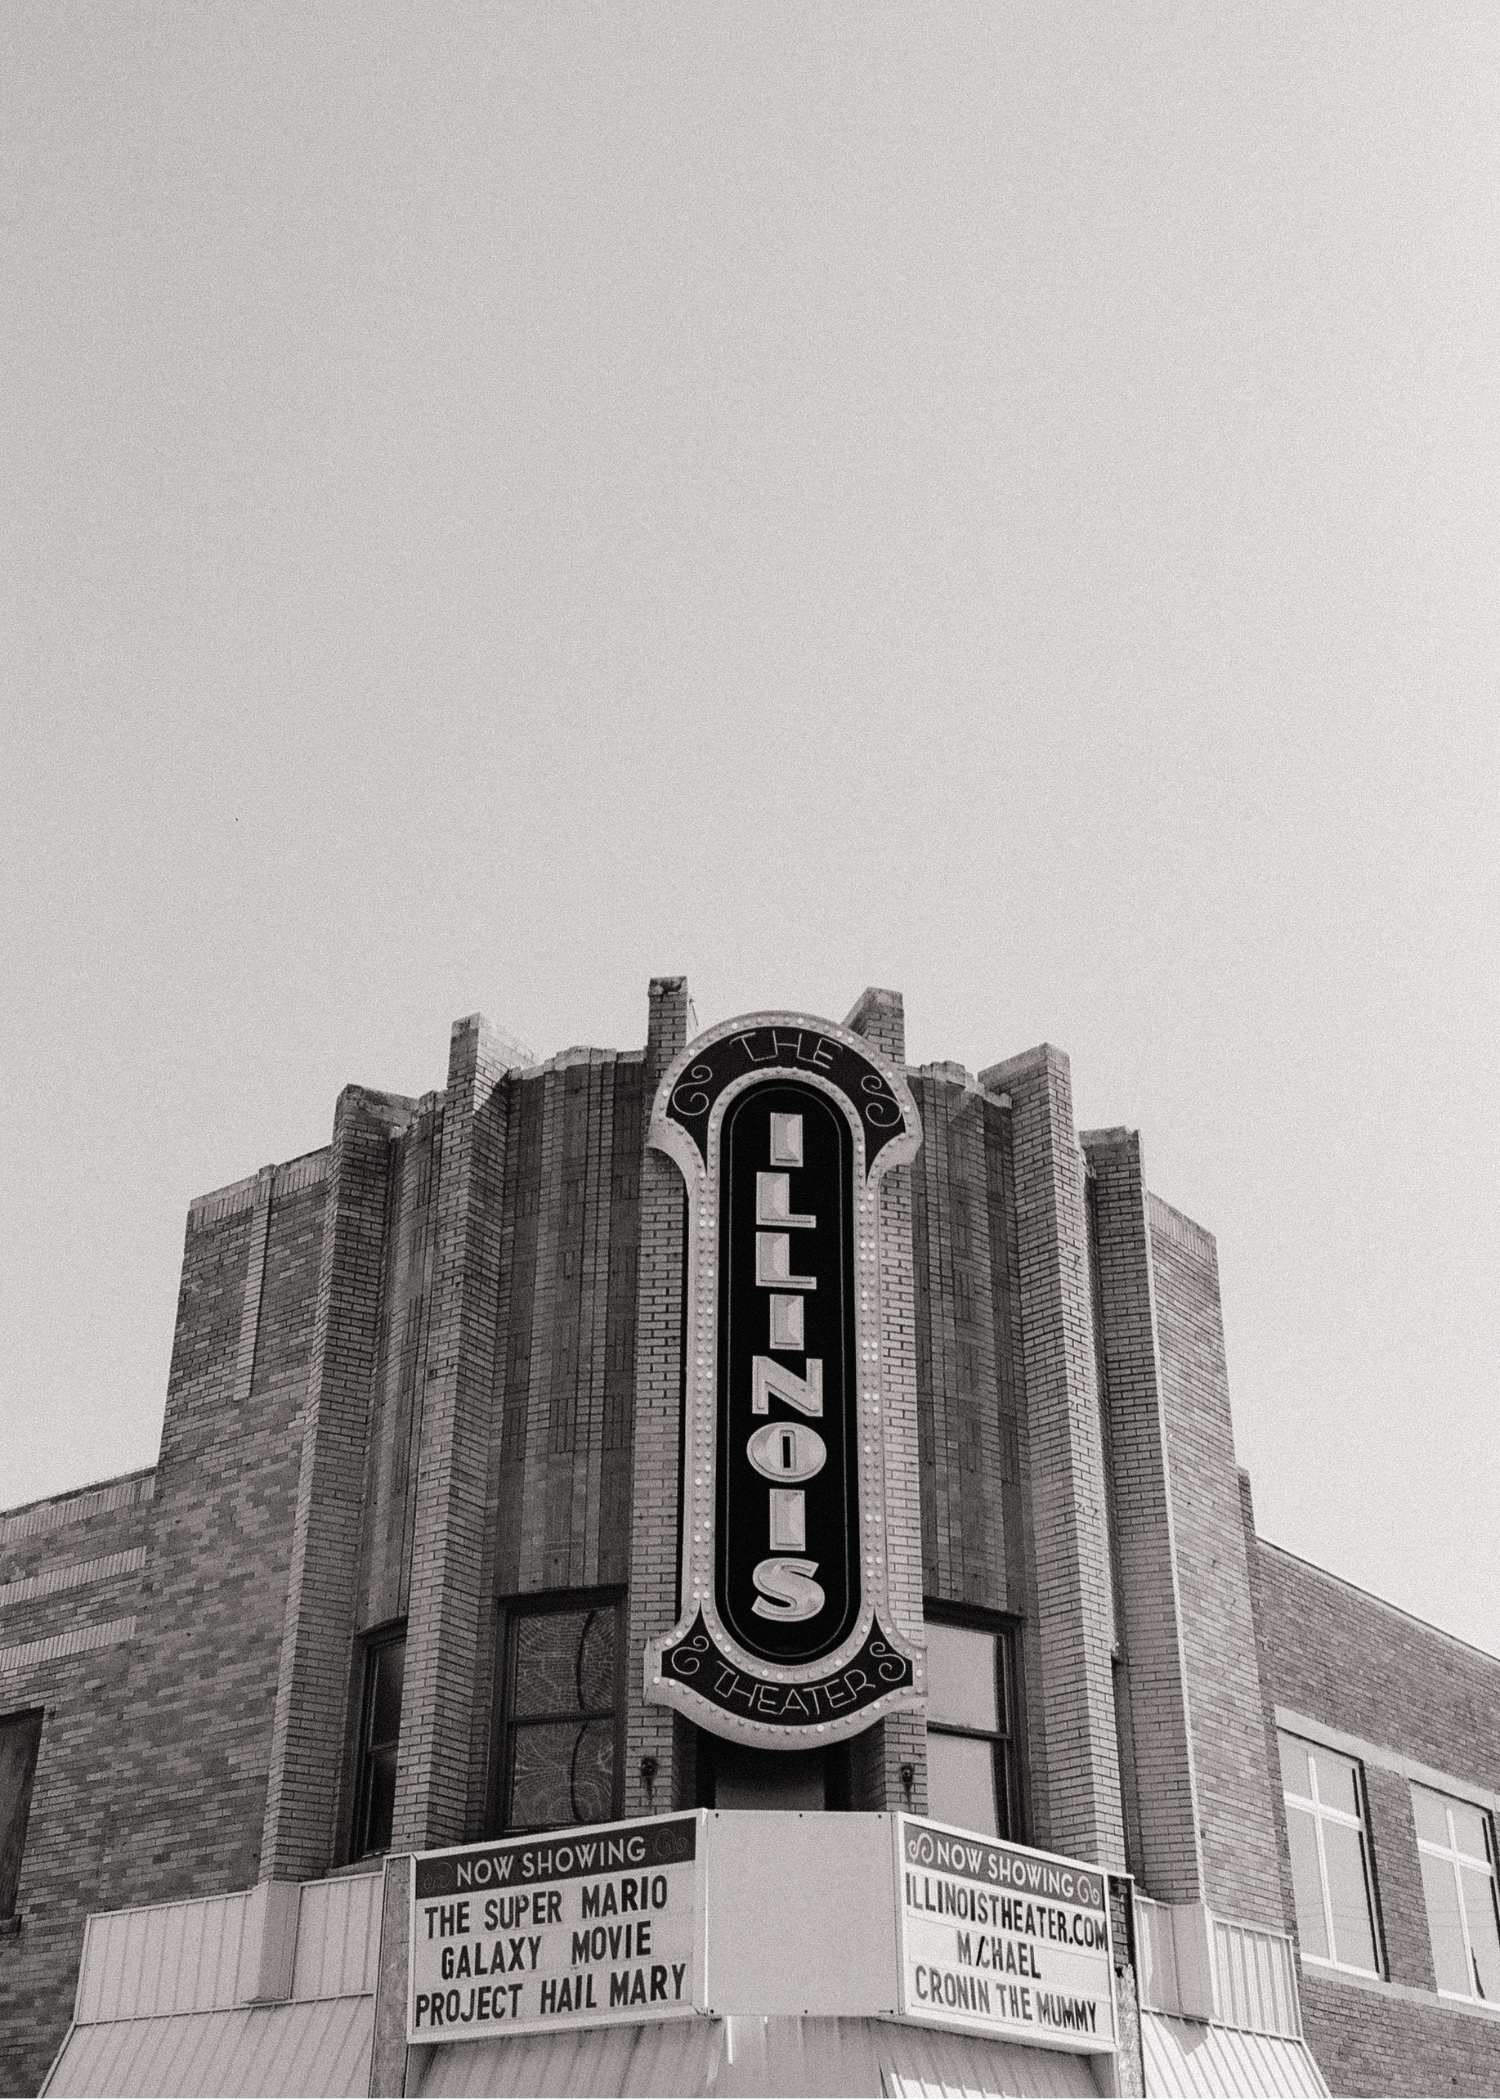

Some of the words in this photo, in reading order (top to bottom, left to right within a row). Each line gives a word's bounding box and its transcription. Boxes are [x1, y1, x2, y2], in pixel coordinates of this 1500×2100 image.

[729, 1029, 843, 1069] THE
[746, 1112, 827, 1622] ILLINOIS
[713, 1660, 876, 1716] THEATER
[457, 1854, 515, 1887] NOW
[522, 1836, 646, 1877] SHOWING
[937, 1840, 982, 1874] NOW
[988, 1854, 1074, 1898] SHOWING
[424, 1901, 470, 1939] THE
[484, 1890, 562, 1931] SUPER
[581, 1875, 668, 1919] MARIO
[905, 1872, 1108, 1950] ILLINOISTHEATER.COM
[441, 1935, 542, 1980] GALAXY
[571, 1920, 651, 1965] MOVIE
[415, 1984, 523, 2027] PROJECT
[540, 1974, 597, 2014] HAIL
[609, 1963, 686, 2007] MARY
[915, 1965, 990, 2014] CRONIN
[996, 1983, 1033, 2020] THE
[1036, 1991, 1097, 2033] MUMMY
